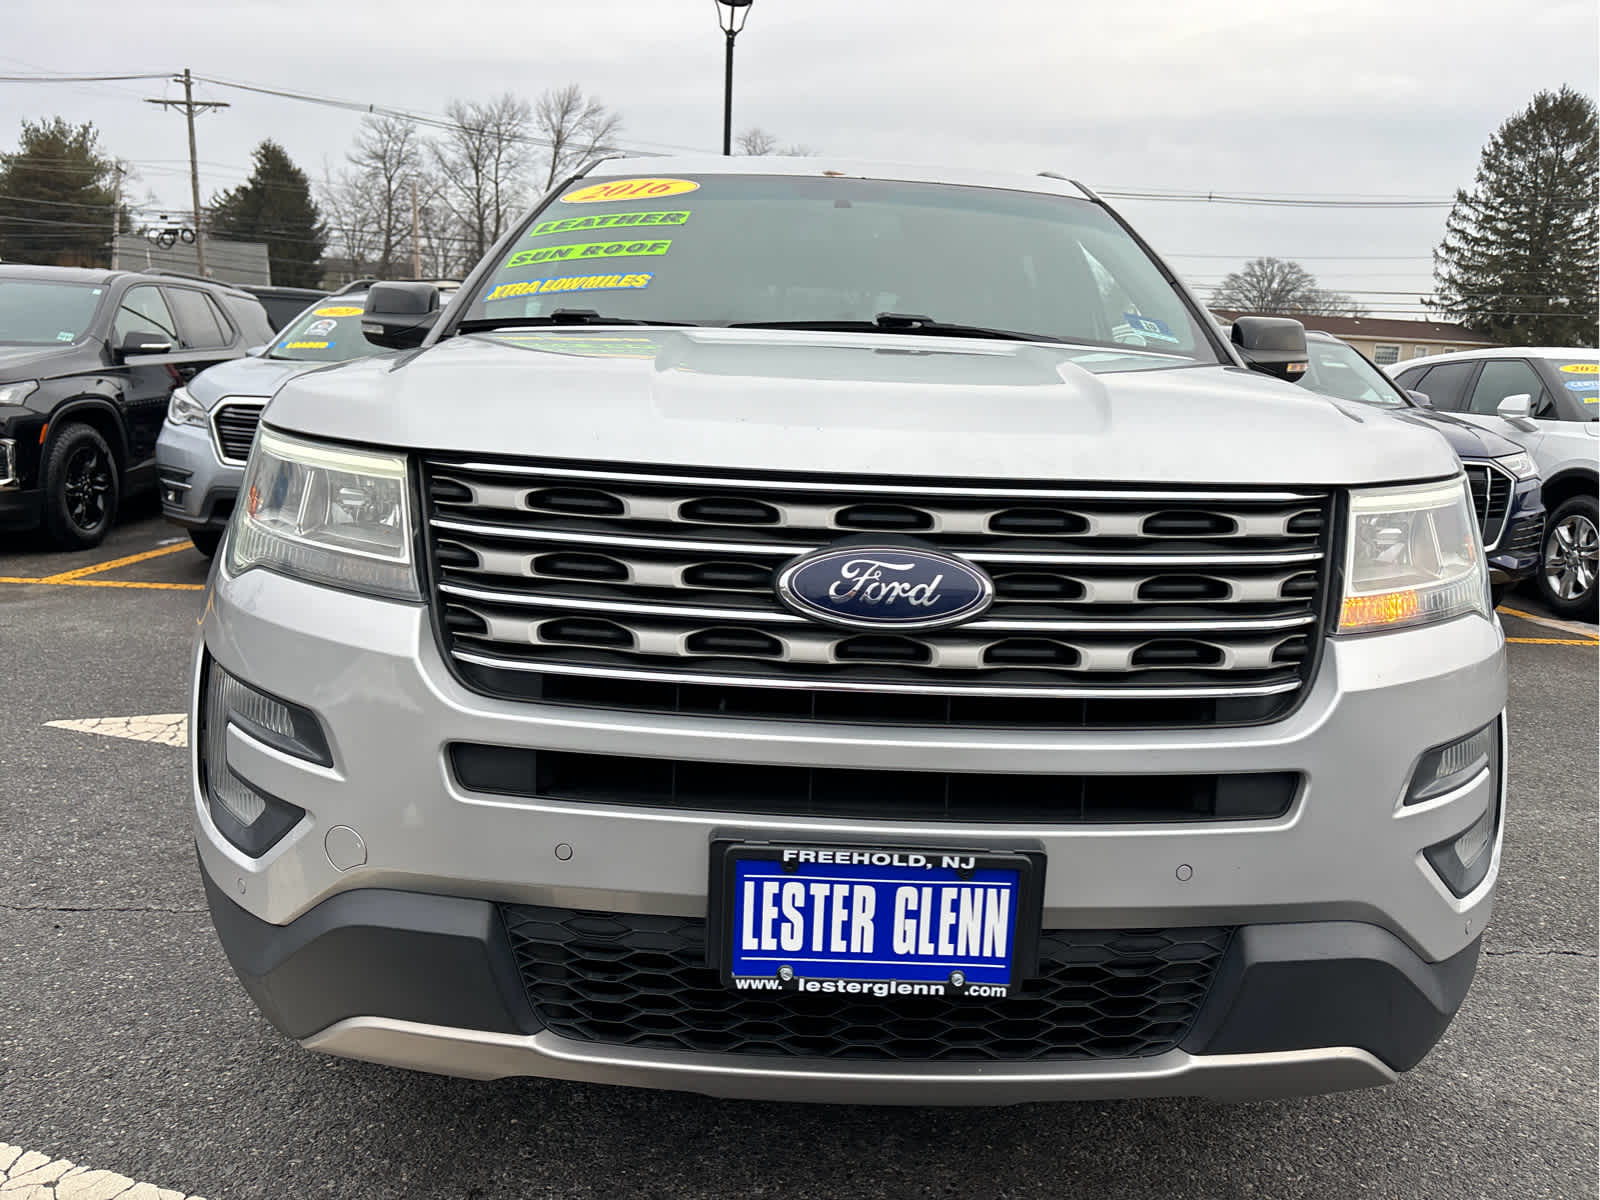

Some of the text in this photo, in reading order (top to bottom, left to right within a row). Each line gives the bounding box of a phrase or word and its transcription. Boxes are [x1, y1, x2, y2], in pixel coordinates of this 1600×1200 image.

[580, 181, 674, 200] 2016
[535, 212, 685, 234] LEATHER
[510, 241, 669, 265] SUN ROOF
[486, 280, 541, 301] XTRA
[828, 559, 943, 606] Ford
[783, 850, 975, 869] FREEHOLD, NJ
[742, 881, 1010, 958] LESTER GLENN
[735, 978, 1007, 998] www. lesterglenn .com
